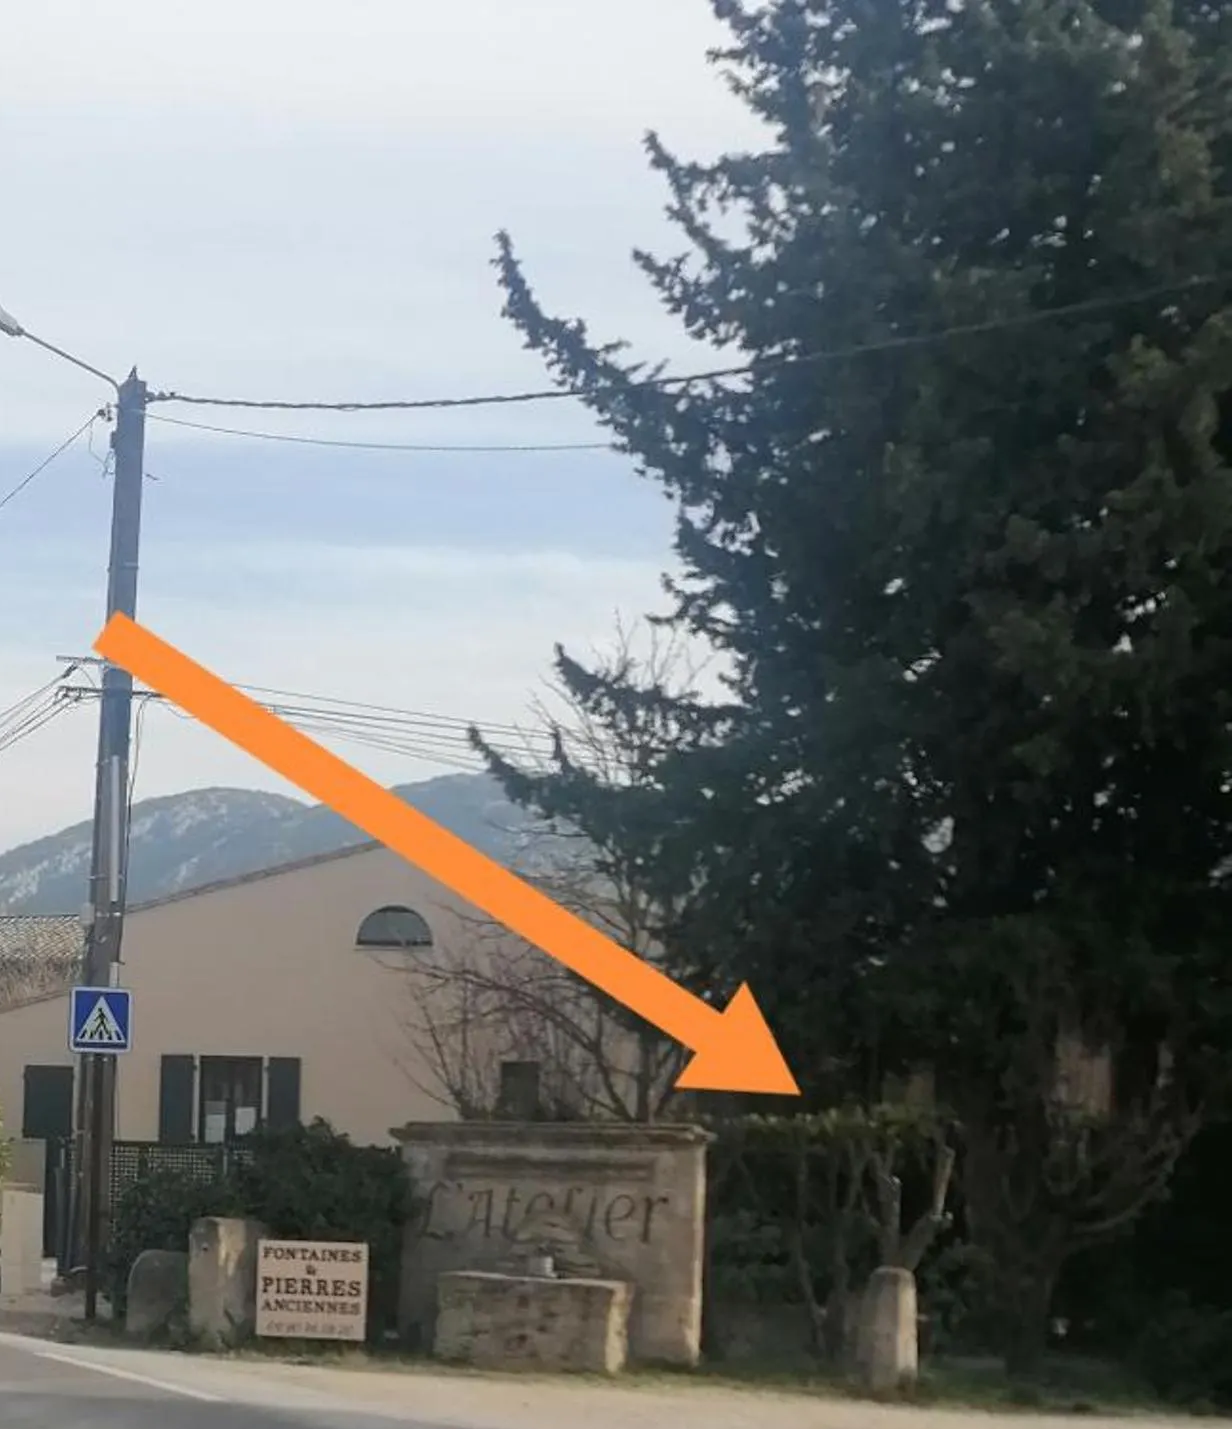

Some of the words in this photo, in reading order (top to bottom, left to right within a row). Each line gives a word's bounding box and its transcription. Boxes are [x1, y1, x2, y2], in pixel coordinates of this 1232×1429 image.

[263, 1247, 362, 1262] FONTAINES
[262, 1277, 361, 1297] PIERRES
[261, 1299, 361, 1315] ANCIENNES
